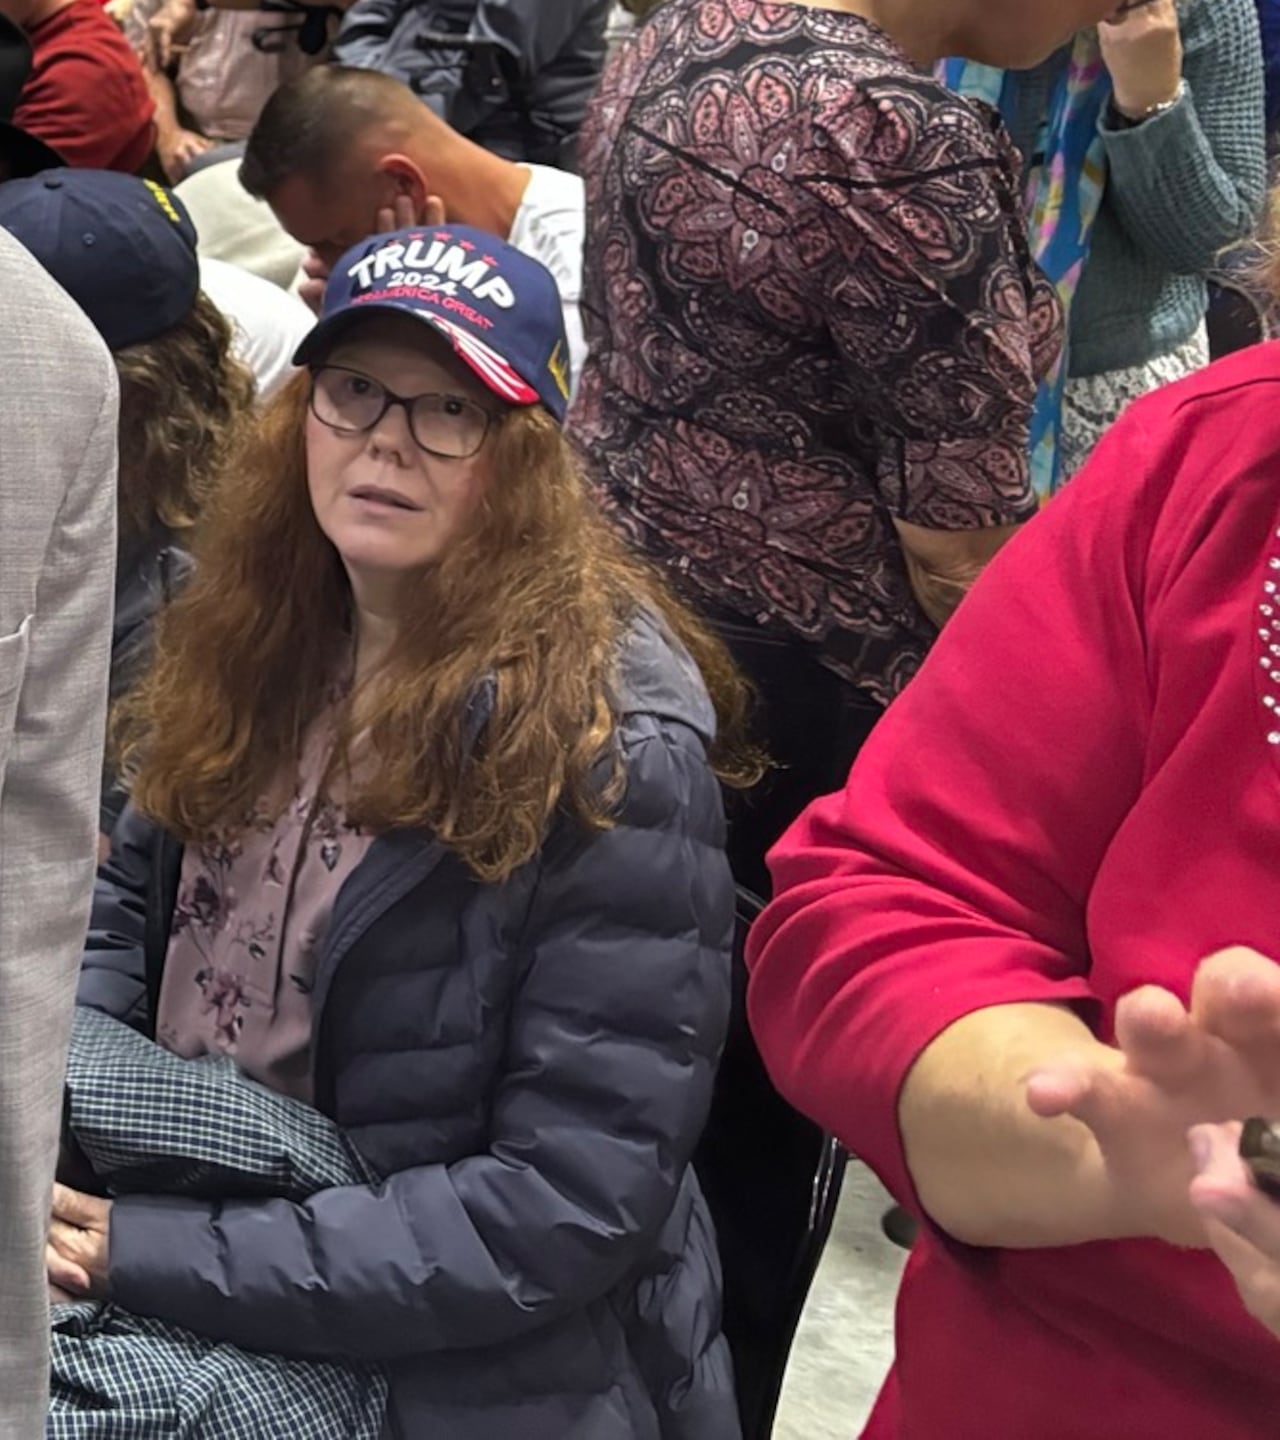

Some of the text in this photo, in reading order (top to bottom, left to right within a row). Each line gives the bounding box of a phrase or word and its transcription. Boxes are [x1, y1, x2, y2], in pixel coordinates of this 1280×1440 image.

[348, 240, 516, 309] TRUMP
[386, 271, 459, 297] 2024
[441, 297, 495, 330] GREAT
